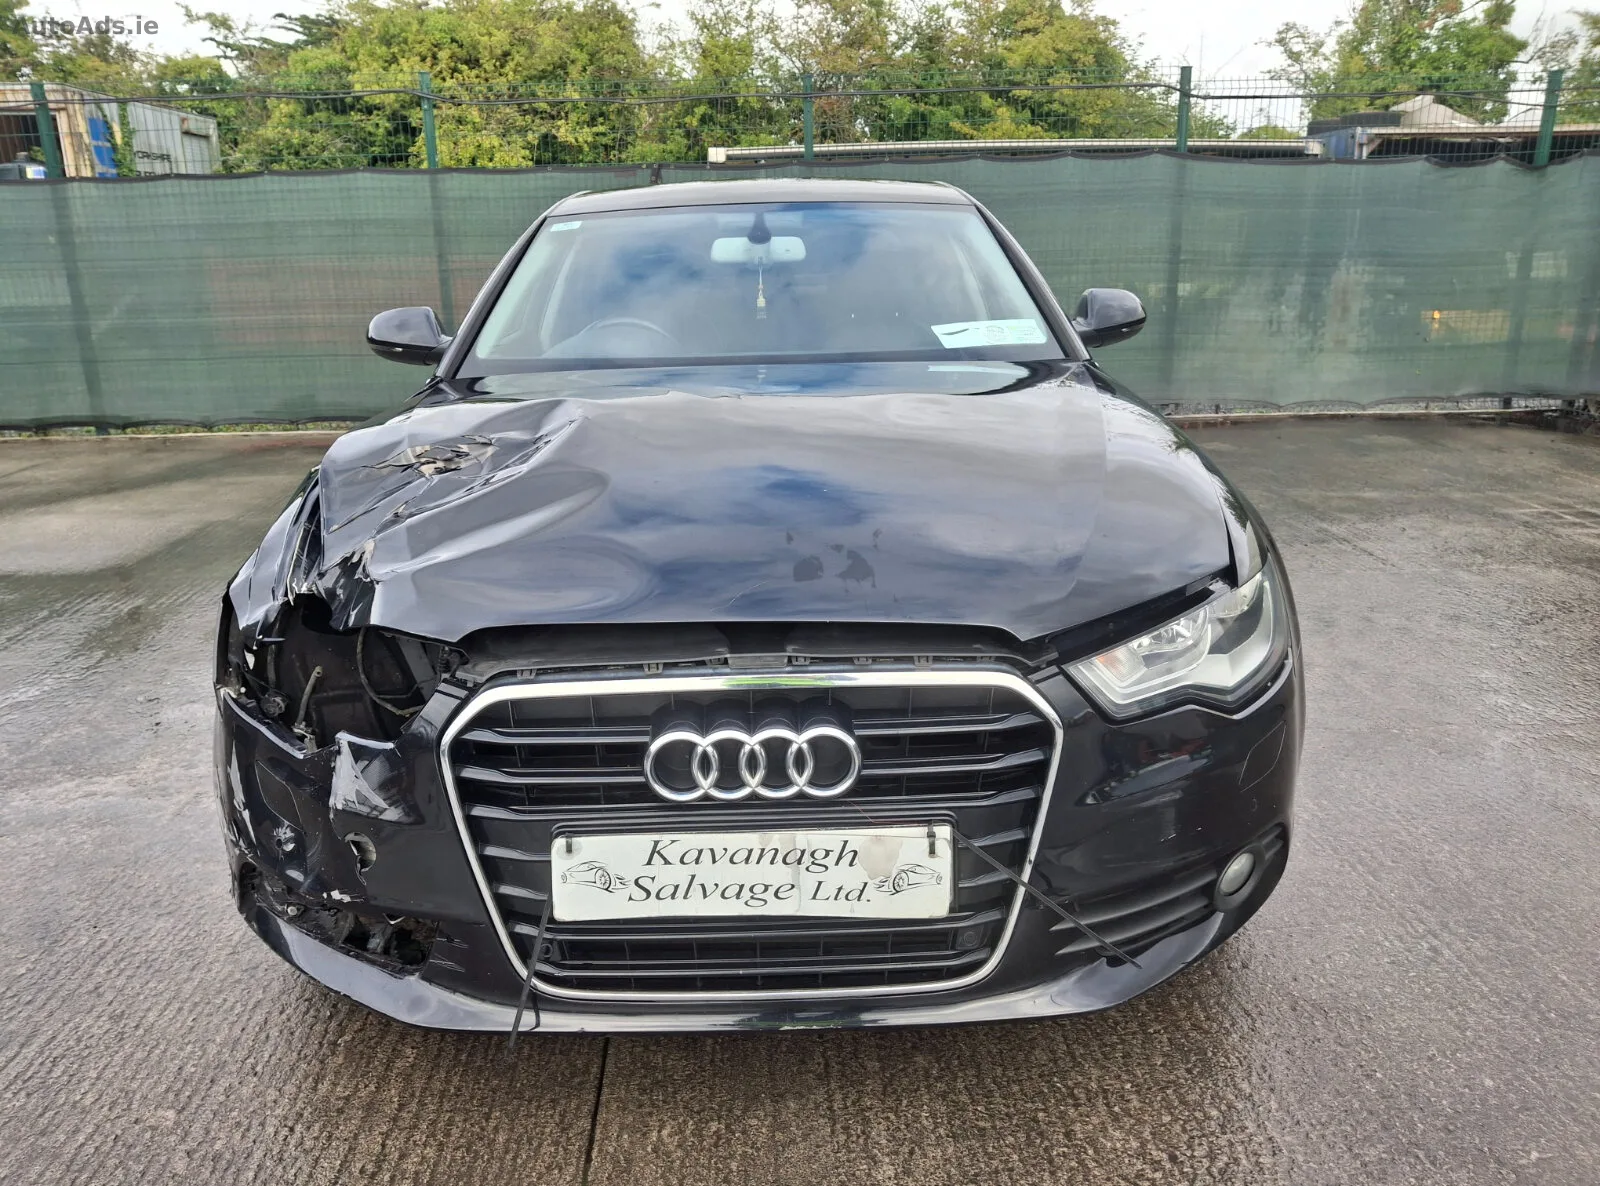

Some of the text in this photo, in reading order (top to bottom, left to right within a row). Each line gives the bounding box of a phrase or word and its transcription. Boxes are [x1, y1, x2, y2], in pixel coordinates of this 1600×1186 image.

[643, 839, 858, 874] Kavanagh
[628, 873, 872, 908] Salvage Ltd.
